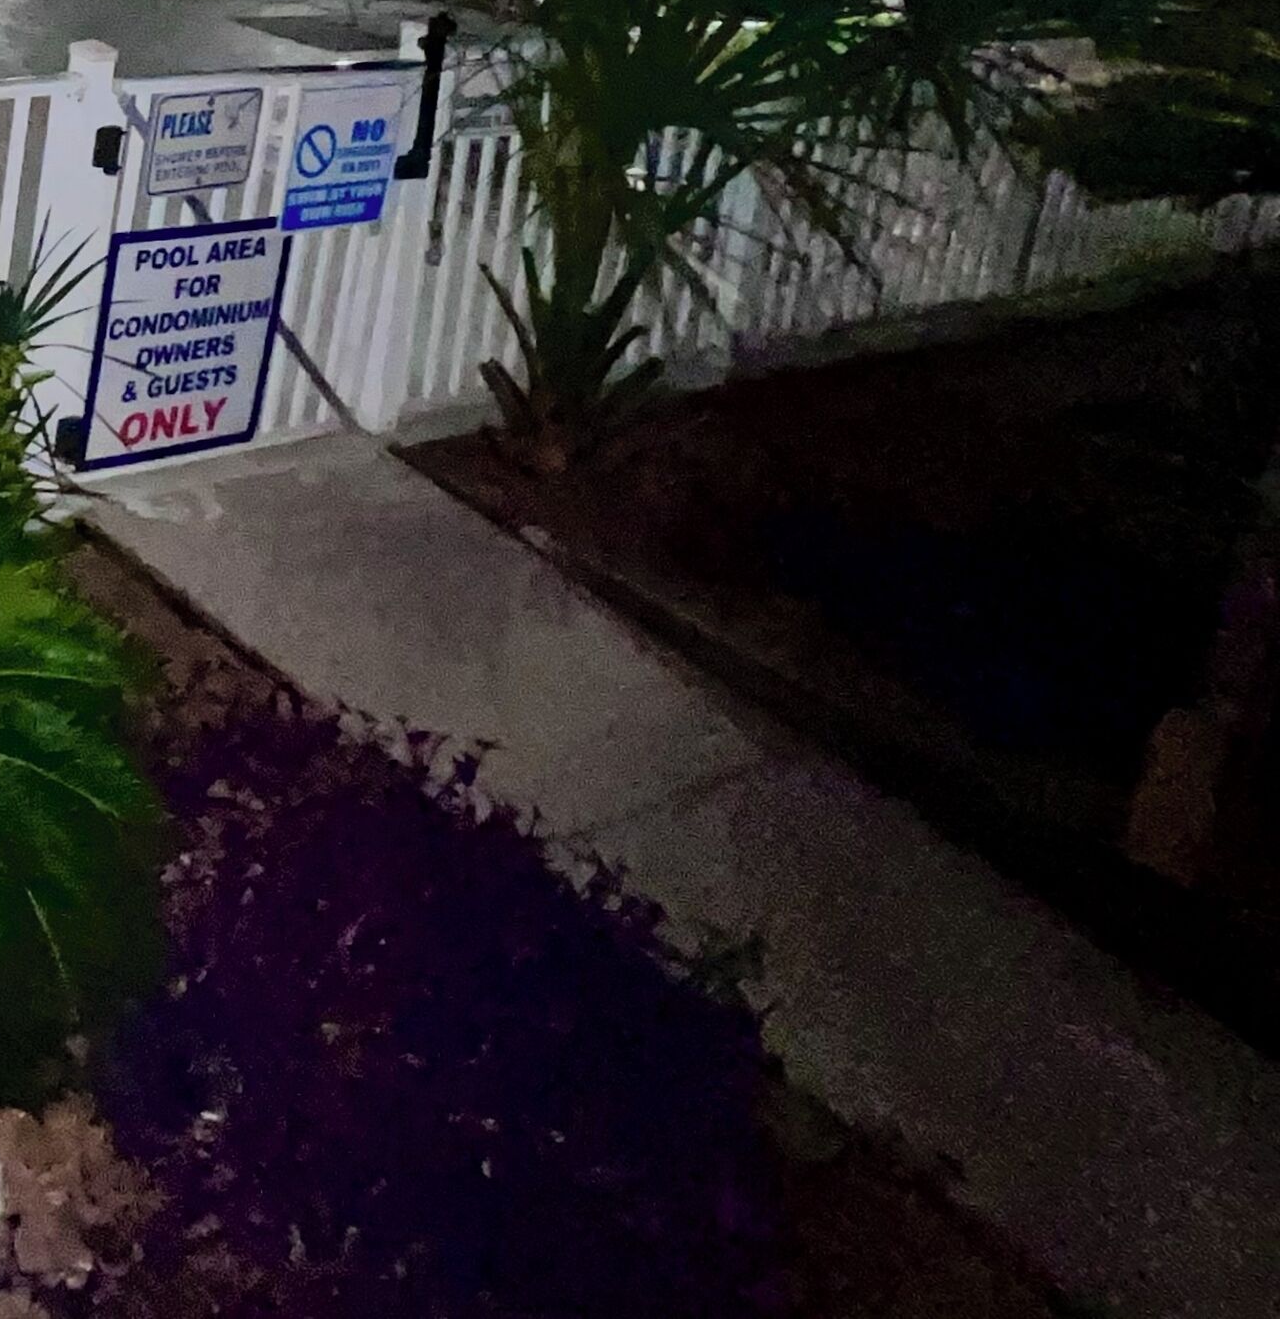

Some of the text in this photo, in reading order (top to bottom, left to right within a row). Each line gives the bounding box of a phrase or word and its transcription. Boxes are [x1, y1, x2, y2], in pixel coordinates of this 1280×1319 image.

[161, 110, 214, 139] PLEASE
[352, 118, 386, 142] NO
[135, 237, 266, 271] POOL AREA
[175, 274, 221, 299] FOR
[109, 298, 272, 340] CONDOMINIUM
[136, 334, 235, 369] OWNERS
[121, 365, 238, 403] & GUESTS
[119, 396, 228, 447] ONLY
